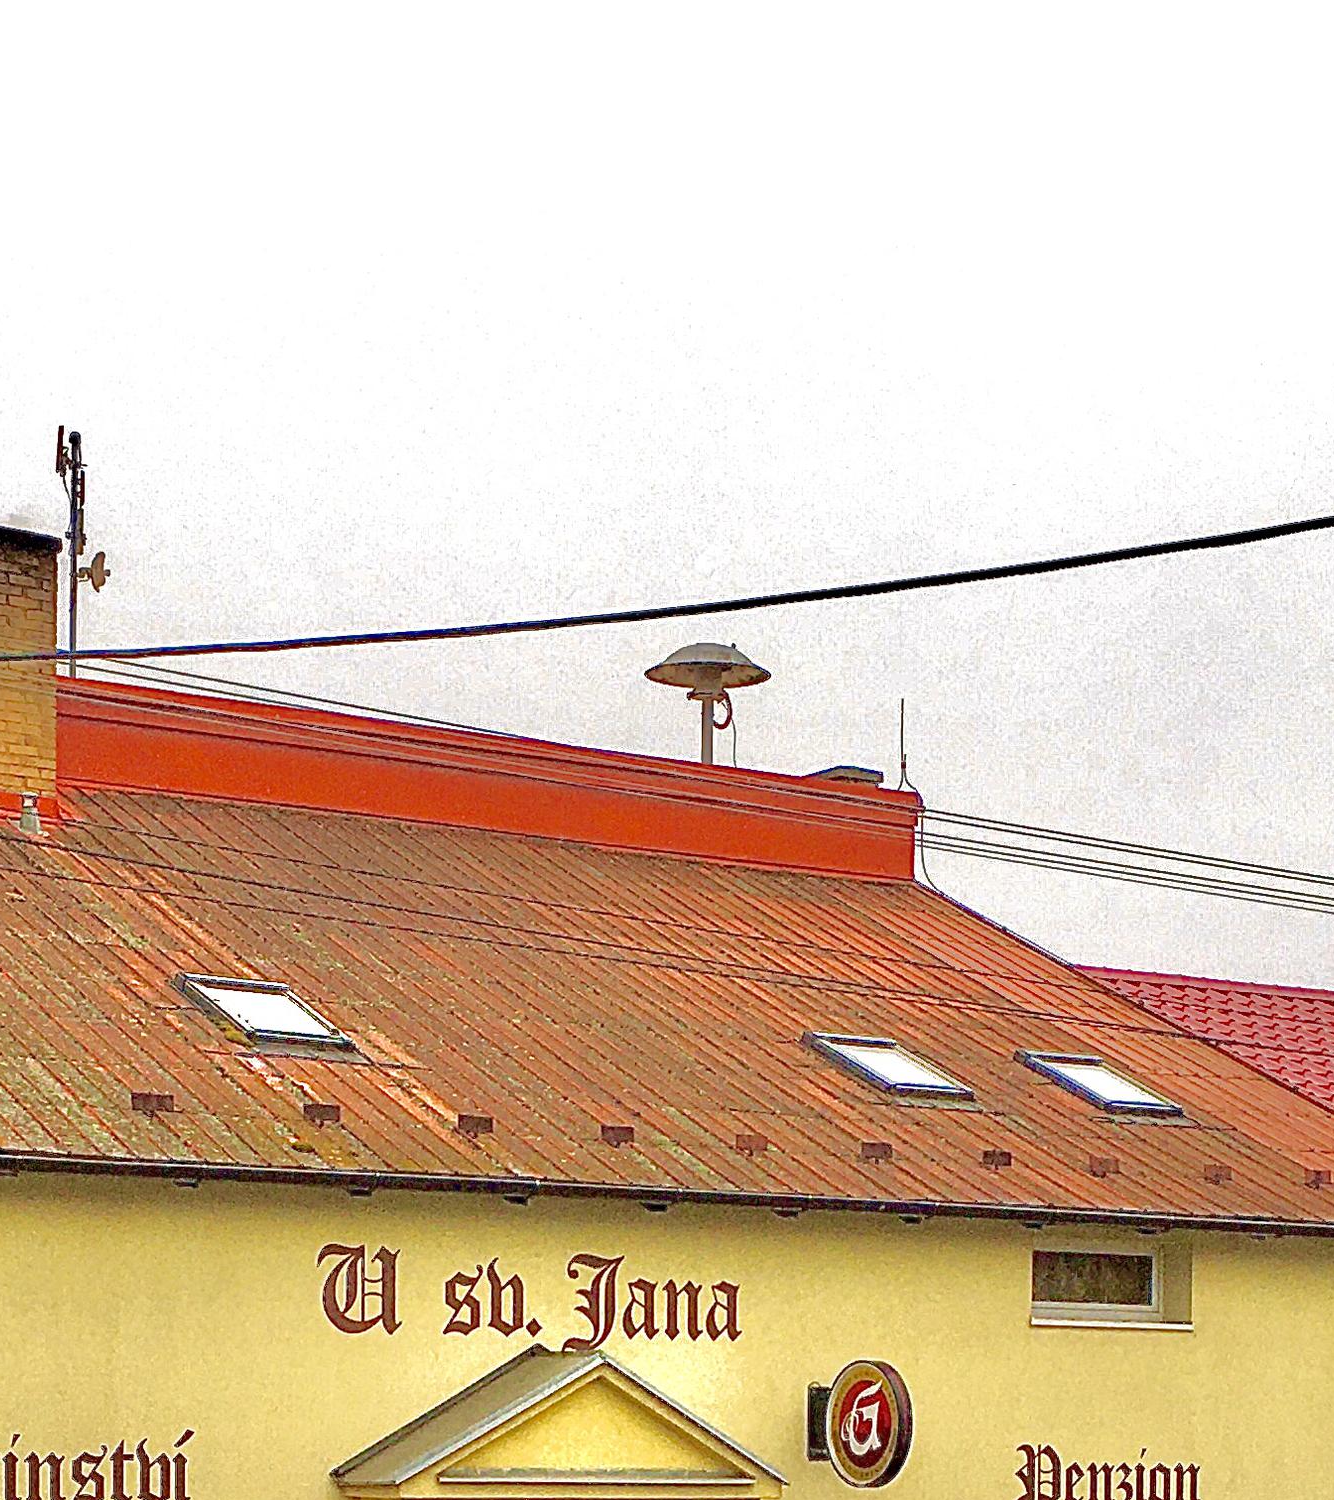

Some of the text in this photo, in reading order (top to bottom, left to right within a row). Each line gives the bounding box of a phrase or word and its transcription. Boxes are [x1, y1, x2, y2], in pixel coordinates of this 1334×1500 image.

[317, 1243, 743, 1352] U sv. Jana
